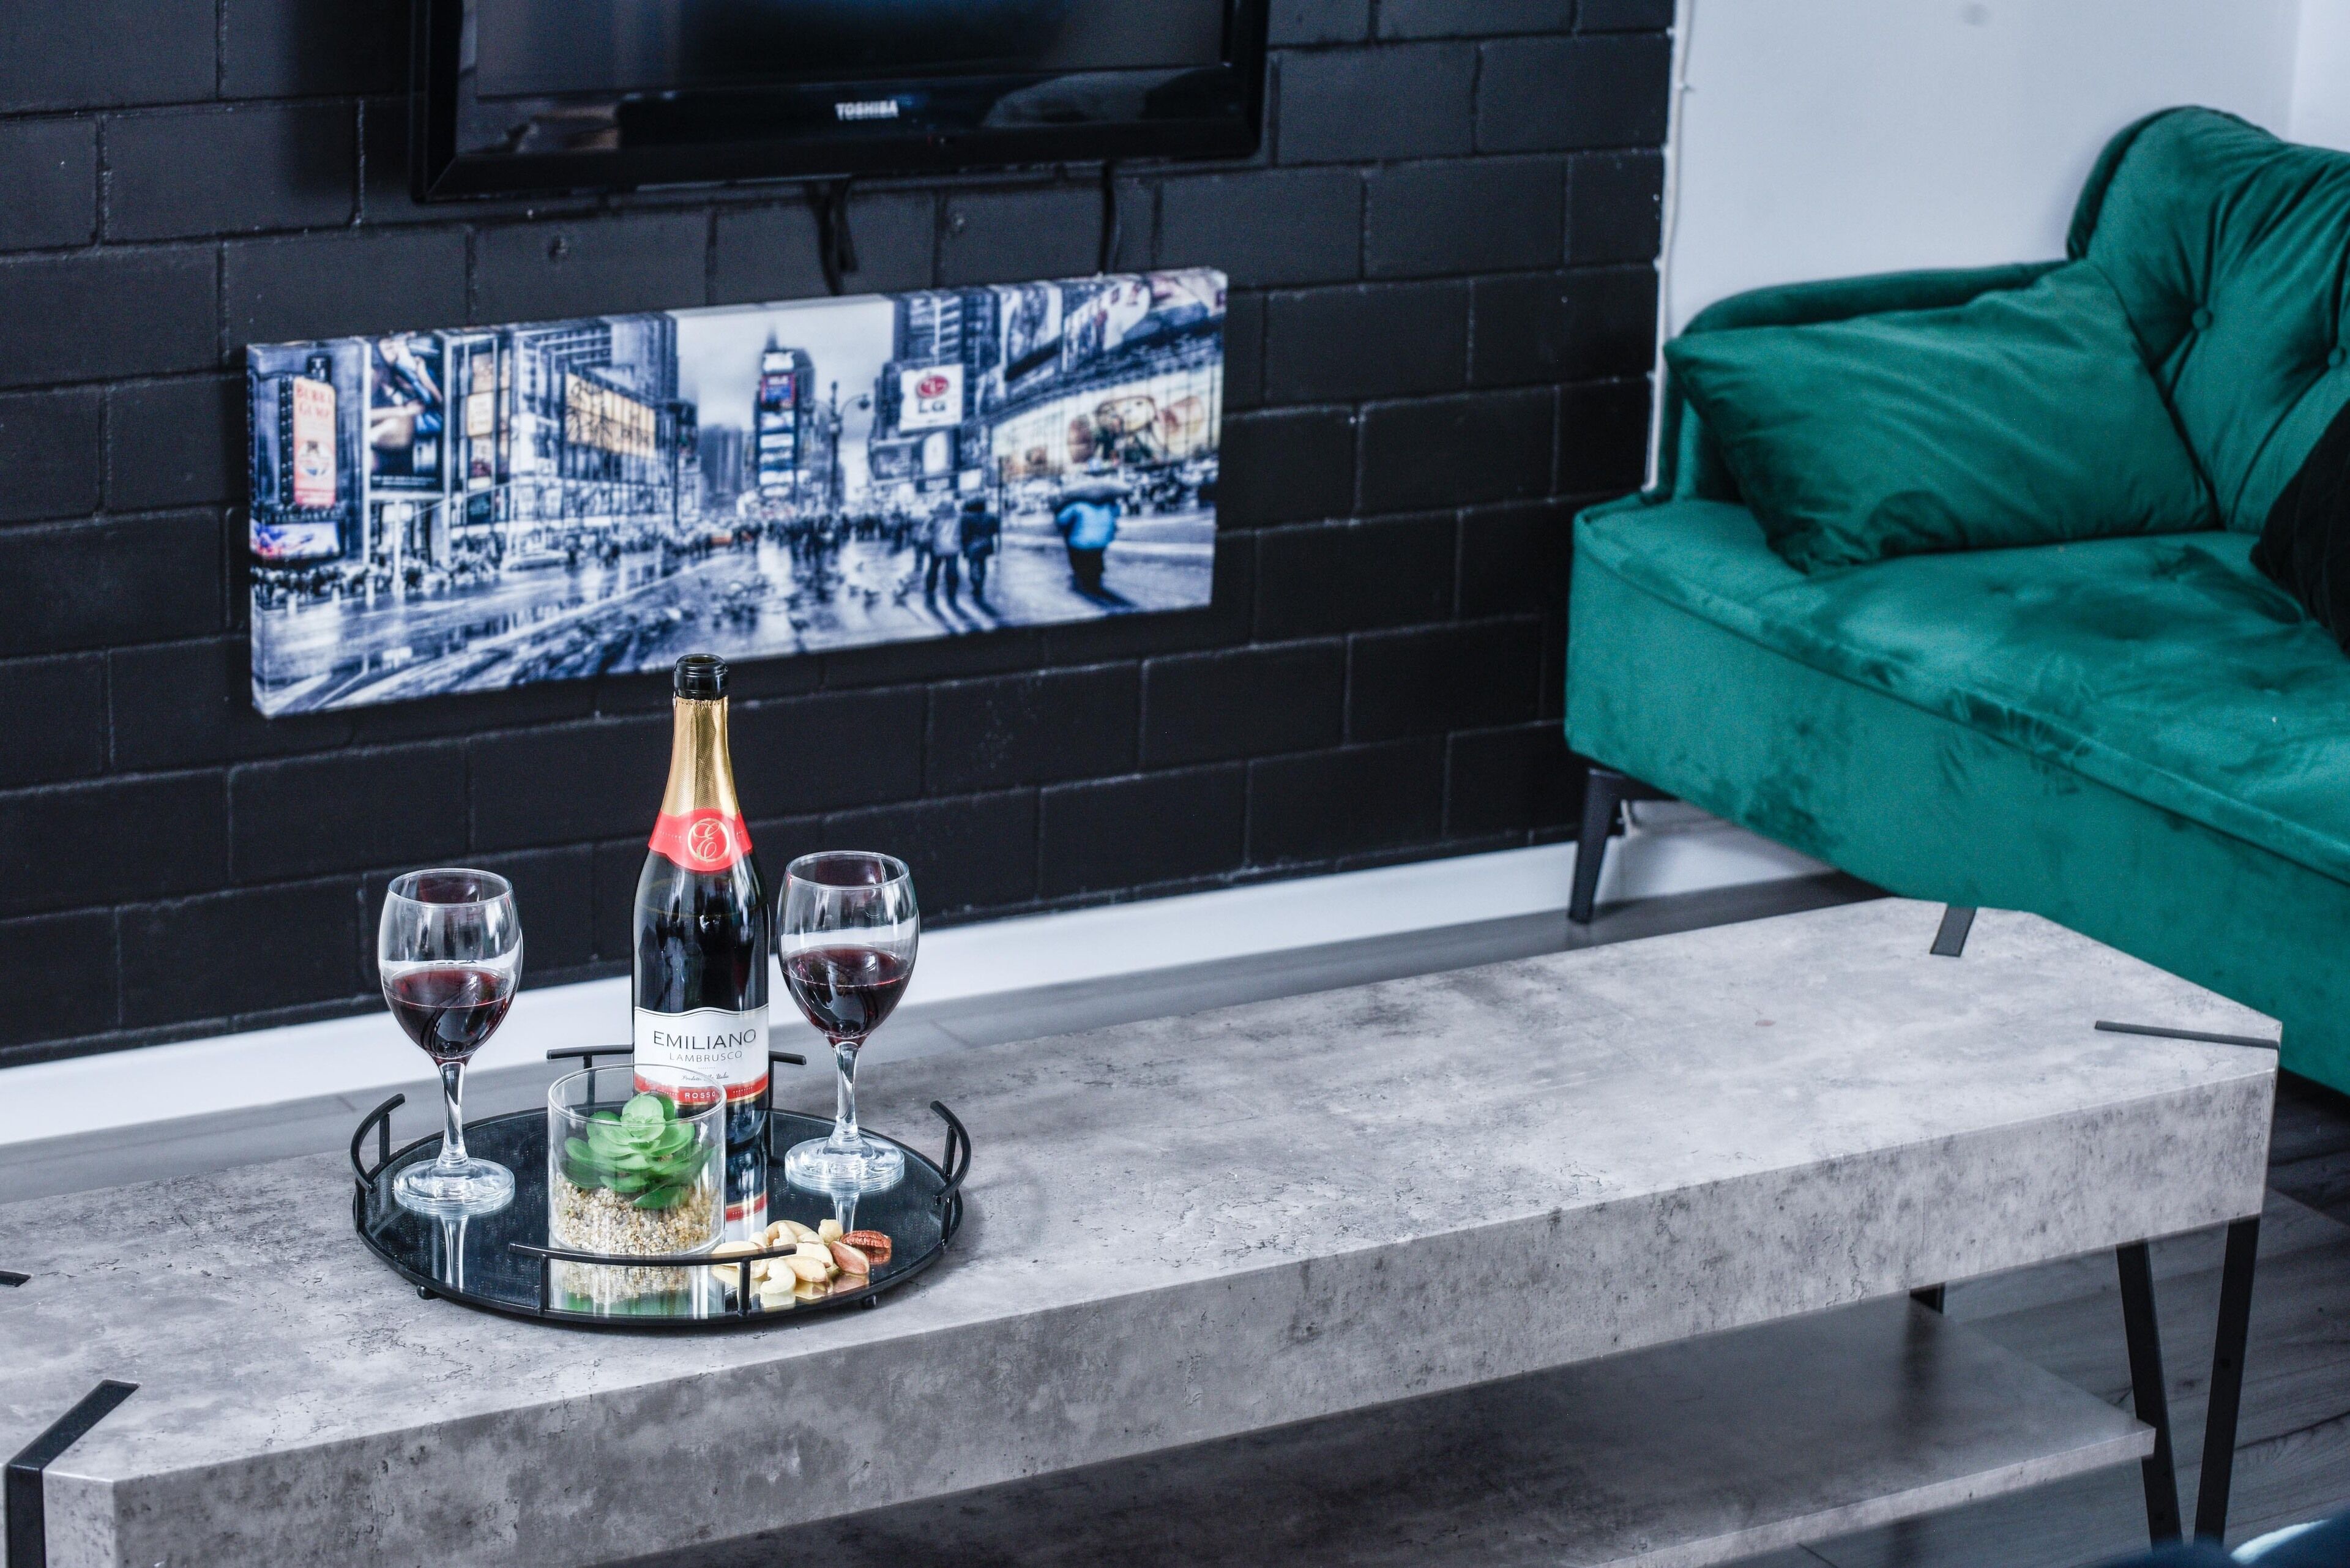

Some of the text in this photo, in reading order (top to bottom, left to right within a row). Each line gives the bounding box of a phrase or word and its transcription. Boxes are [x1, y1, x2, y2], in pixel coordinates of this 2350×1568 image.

[835, 100, 898, 120] TOSHIBA
[919, 400, 946, 413] LG
[654, 1029, 756, 1050] EMILIANO
[670, 1050, 742, 1062] LAMBRUSCO
